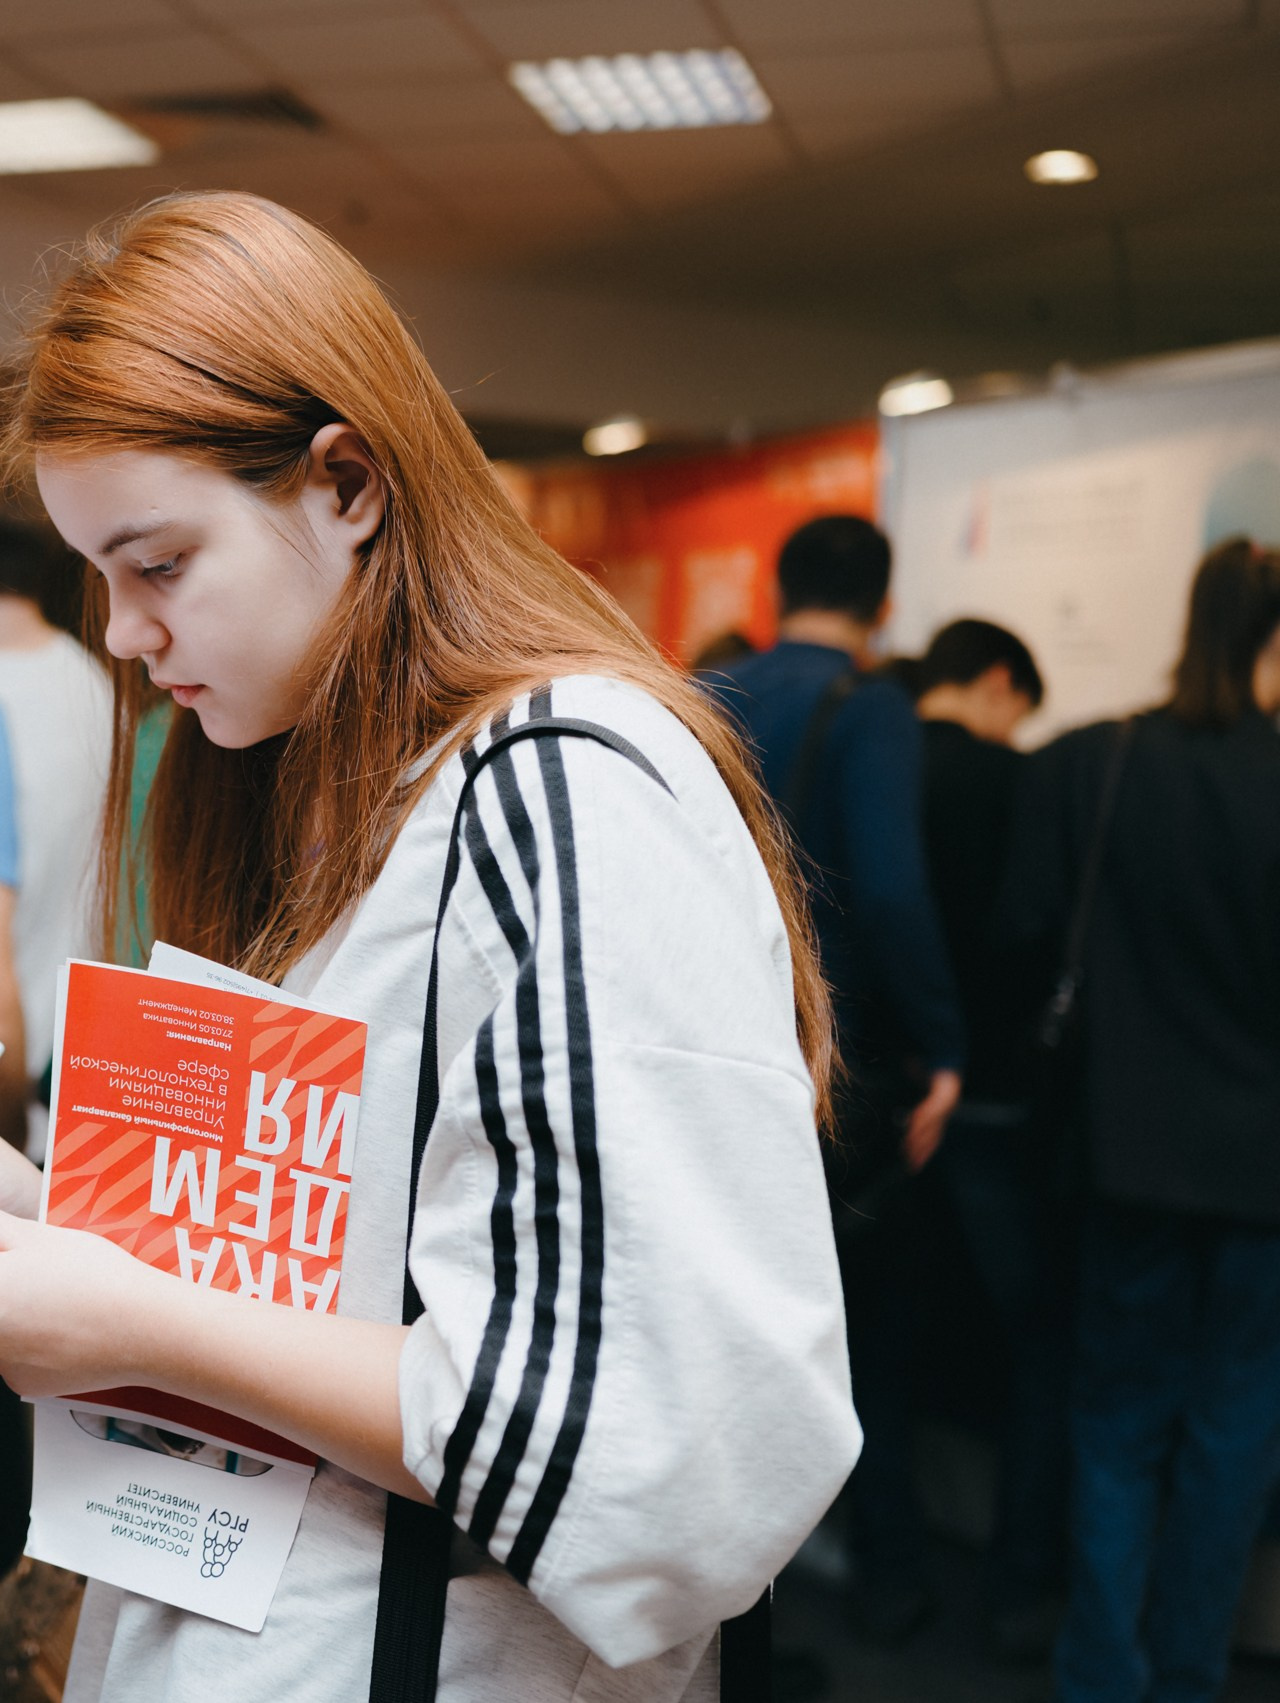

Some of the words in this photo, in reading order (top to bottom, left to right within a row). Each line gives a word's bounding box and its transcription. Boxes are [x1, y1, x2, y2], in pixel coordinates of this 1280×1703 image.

[138, 998, 197, 1017] Менеджмент
[143, 1012, 197, 1030] Инноватика
[199, 1010, 234, 1025] 38.03.02
[166, 1030, 232, 1051] Направления:
[199, 1024, 233, 1038] 27.03.05
[70, 1055, 214, 1093] технологической
[177, 1059, 230, 1081] сфере
[109, 1077, 226, 1111] инновациями
[218, 1084, 228, 1096] в
[72, 1104, 132, 1122] бакалавриат
[122, 1095, 225, 1130] Управление
[244, 1070, 361, 1177] ИЯ
[134, 1116, 223, 1143] Многопрофильный
[149, 1135, 352, 1259] ДЕМ
[116, 1494, 198, 1527] СОЦИАЛЬНЫЙ
[127, 1482, 201, 1513] УНИВЕРСИТЕТ
[86, 1500, 194, 1543] ГОСУДАРСТВЕННЫЙ
[207, 1508, 250, 1533] РГСУ
[111, 1523, 190, 1557] РОССИЙСКИЙ
